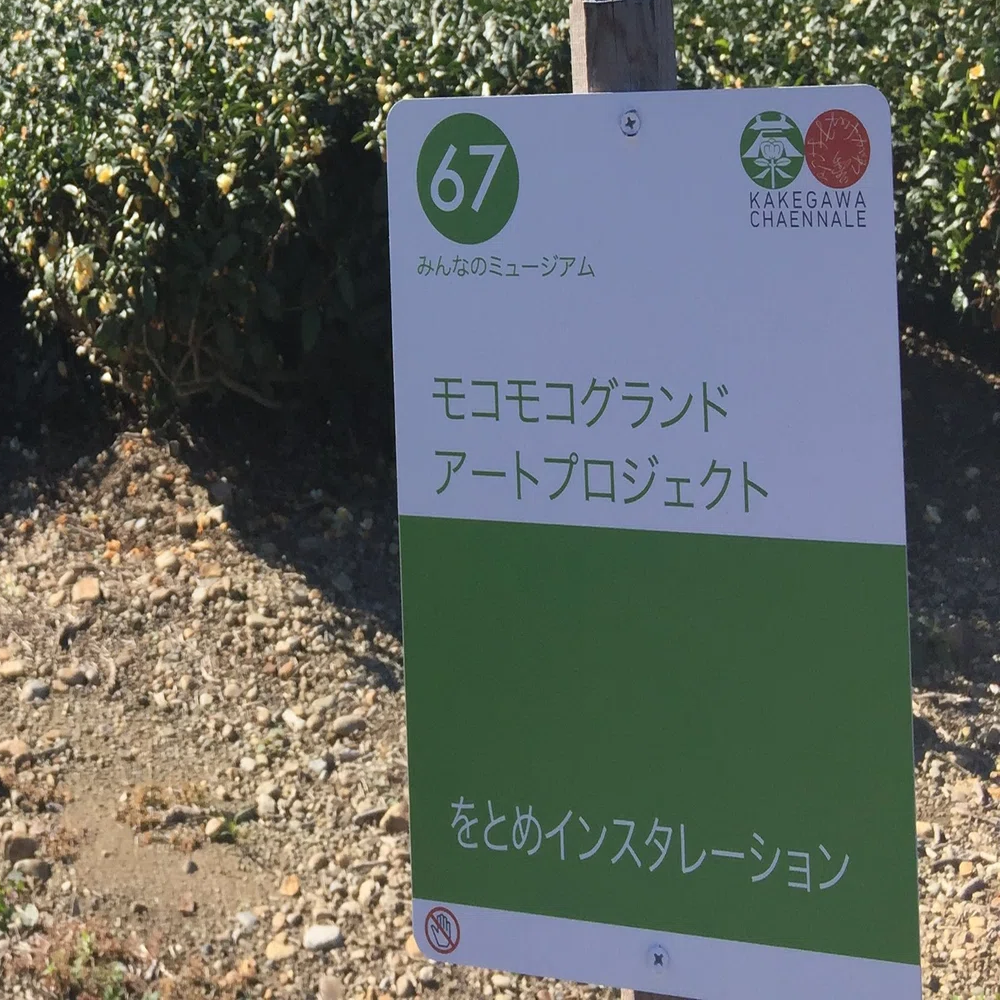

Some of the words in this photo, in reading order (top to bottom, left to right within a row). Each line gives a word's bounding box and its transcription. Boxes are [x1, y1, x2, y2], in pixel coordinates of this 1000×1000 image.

[430, 143, 508, 213] 67
[749, 191, 867, 209] KAKEGAWA
[750, 210, 867, 228] CHAENNALE
[417, 254, 596, 278] みんなのミュージアム
[432, 376, 729, 433] モコモコグランド
[434, 450, 769, 513] アートプロジェクト
[451, 796, 850, 892] をとめインスタレーション
